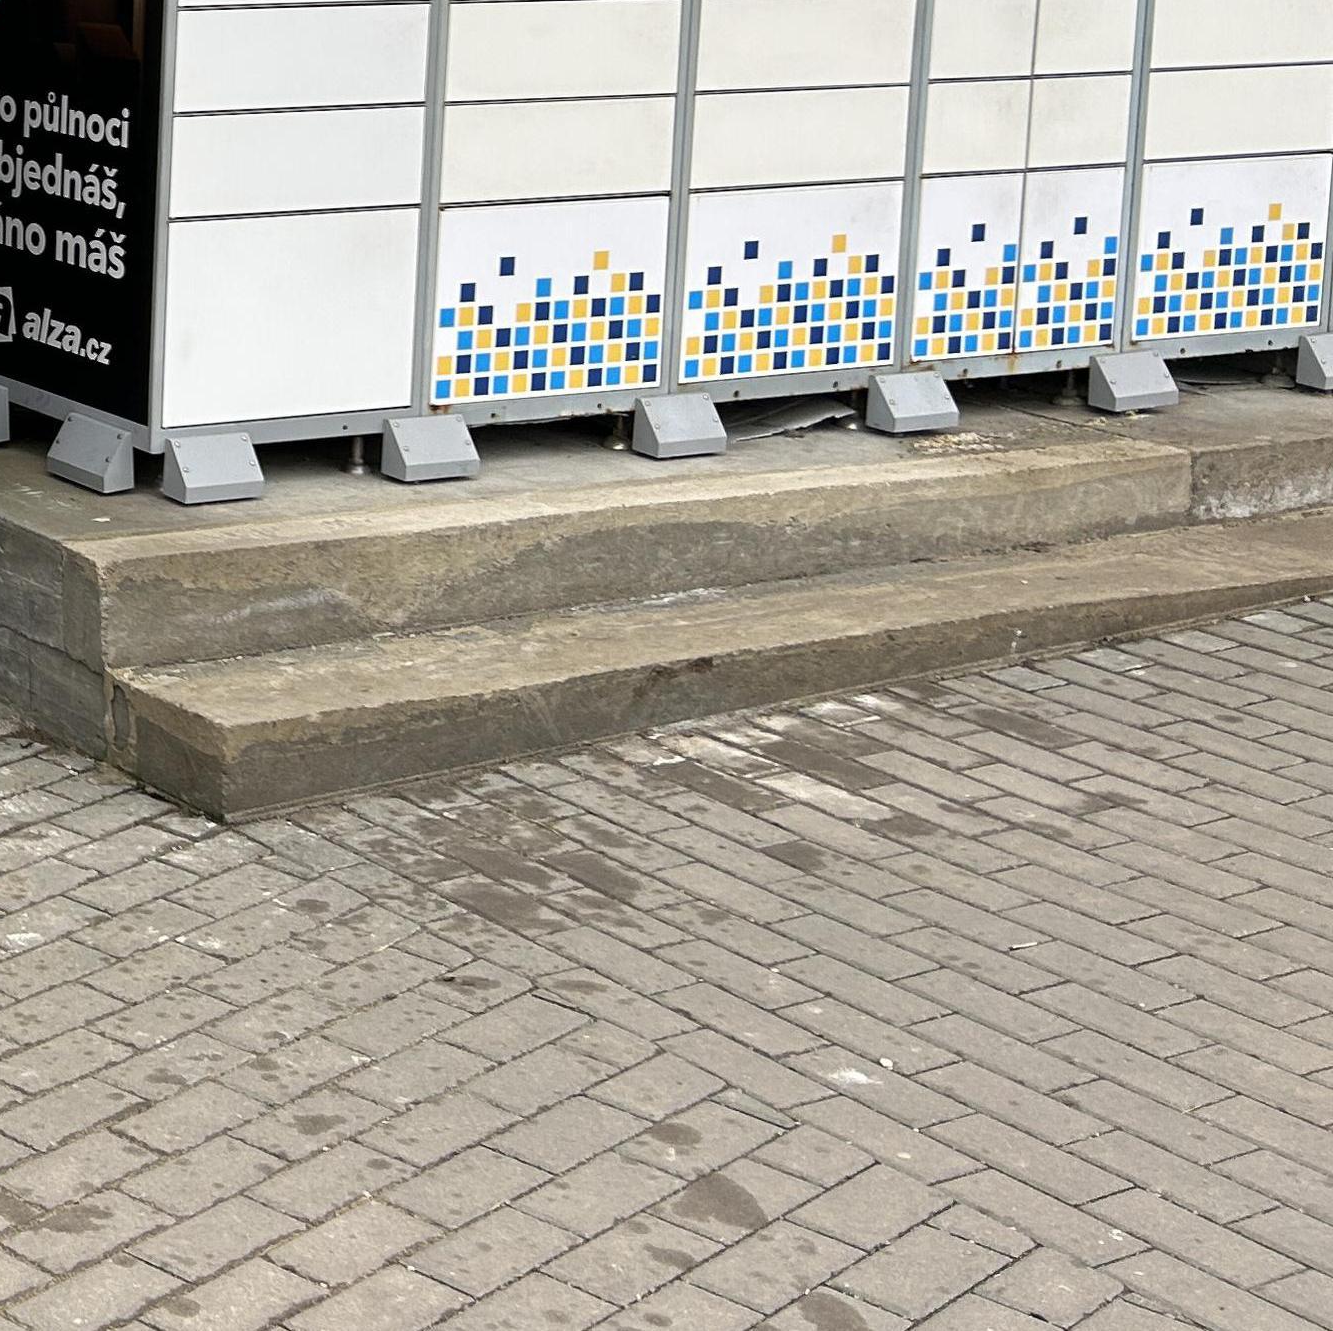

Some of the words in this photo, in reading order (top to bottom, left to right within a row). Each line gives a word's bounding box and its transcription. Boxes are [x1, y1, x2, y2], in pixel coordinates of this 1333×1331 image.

[23, 90, 130, 149] půlnoci
[54, 227, 127, 280] máš
[21, 307, 113, 366] alza.cz
